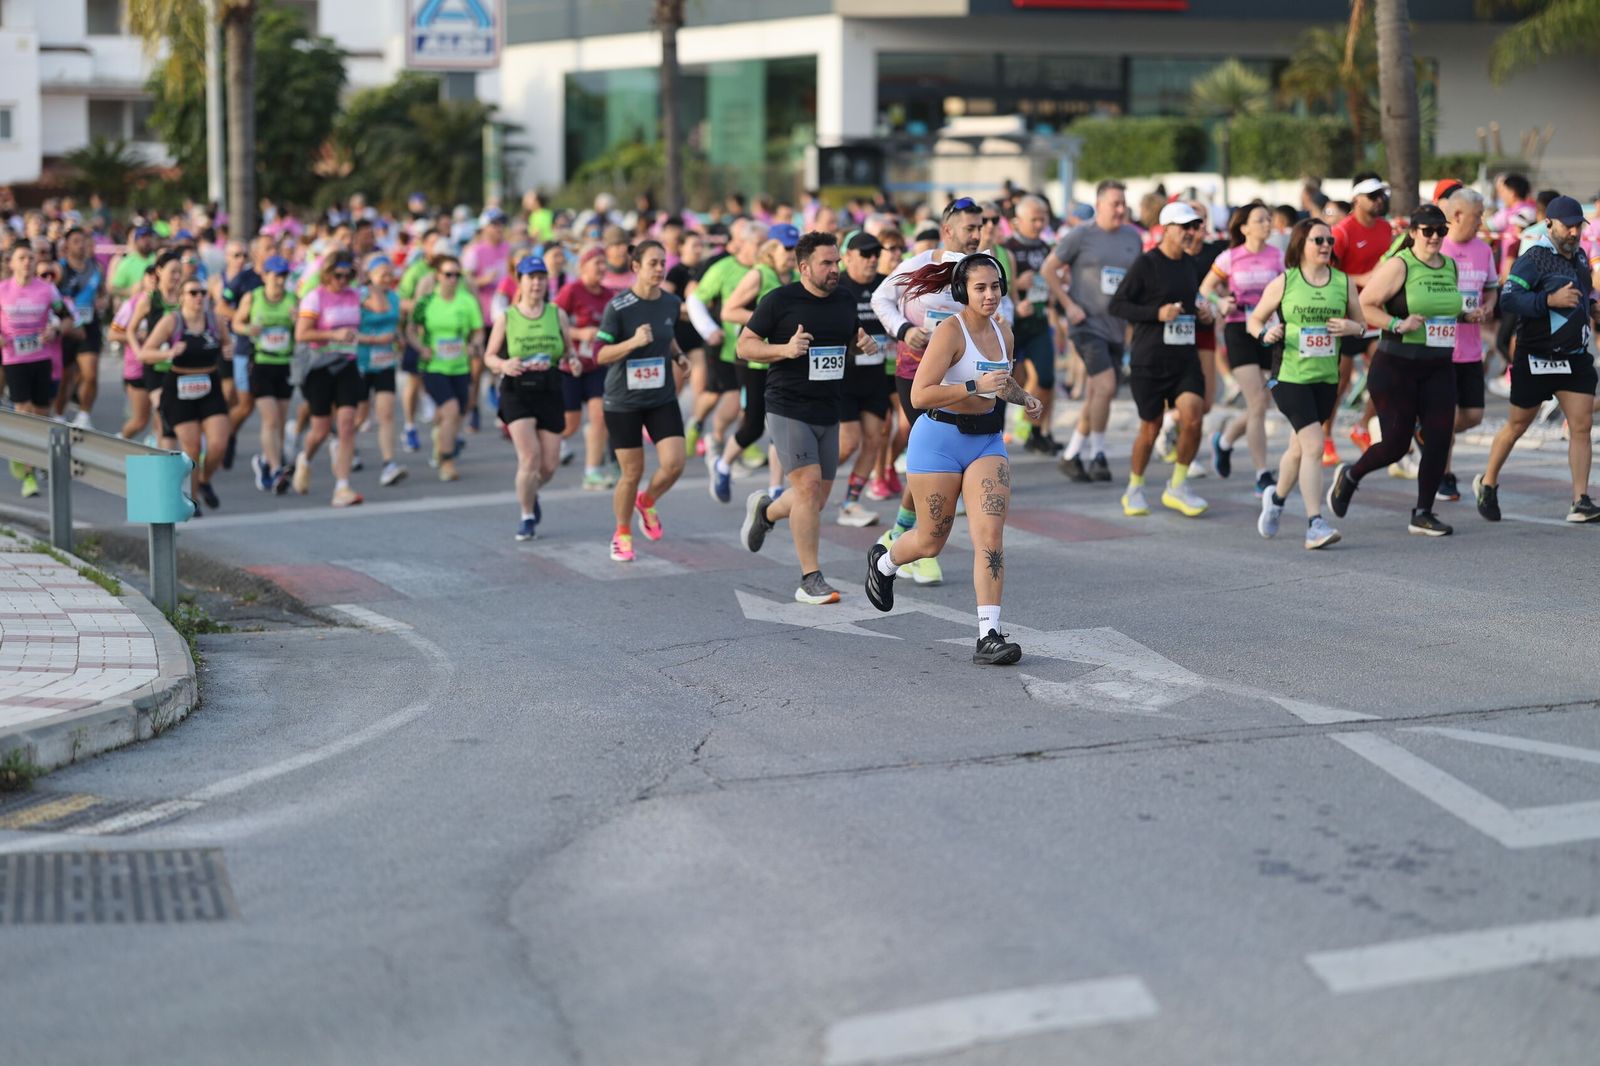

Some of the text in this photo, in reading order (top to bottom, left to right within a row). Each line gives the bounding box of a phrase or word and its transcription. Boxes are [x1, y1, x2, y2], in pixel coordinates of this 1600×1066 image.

[1292, 305, 1341, 316] Porterstown
[1428, 325, 1456, 337] 2162
[1306, 335, 1332, 347] 583
[813, 356, 844, 370] 1293
[634, 367, 660, 379] 434
